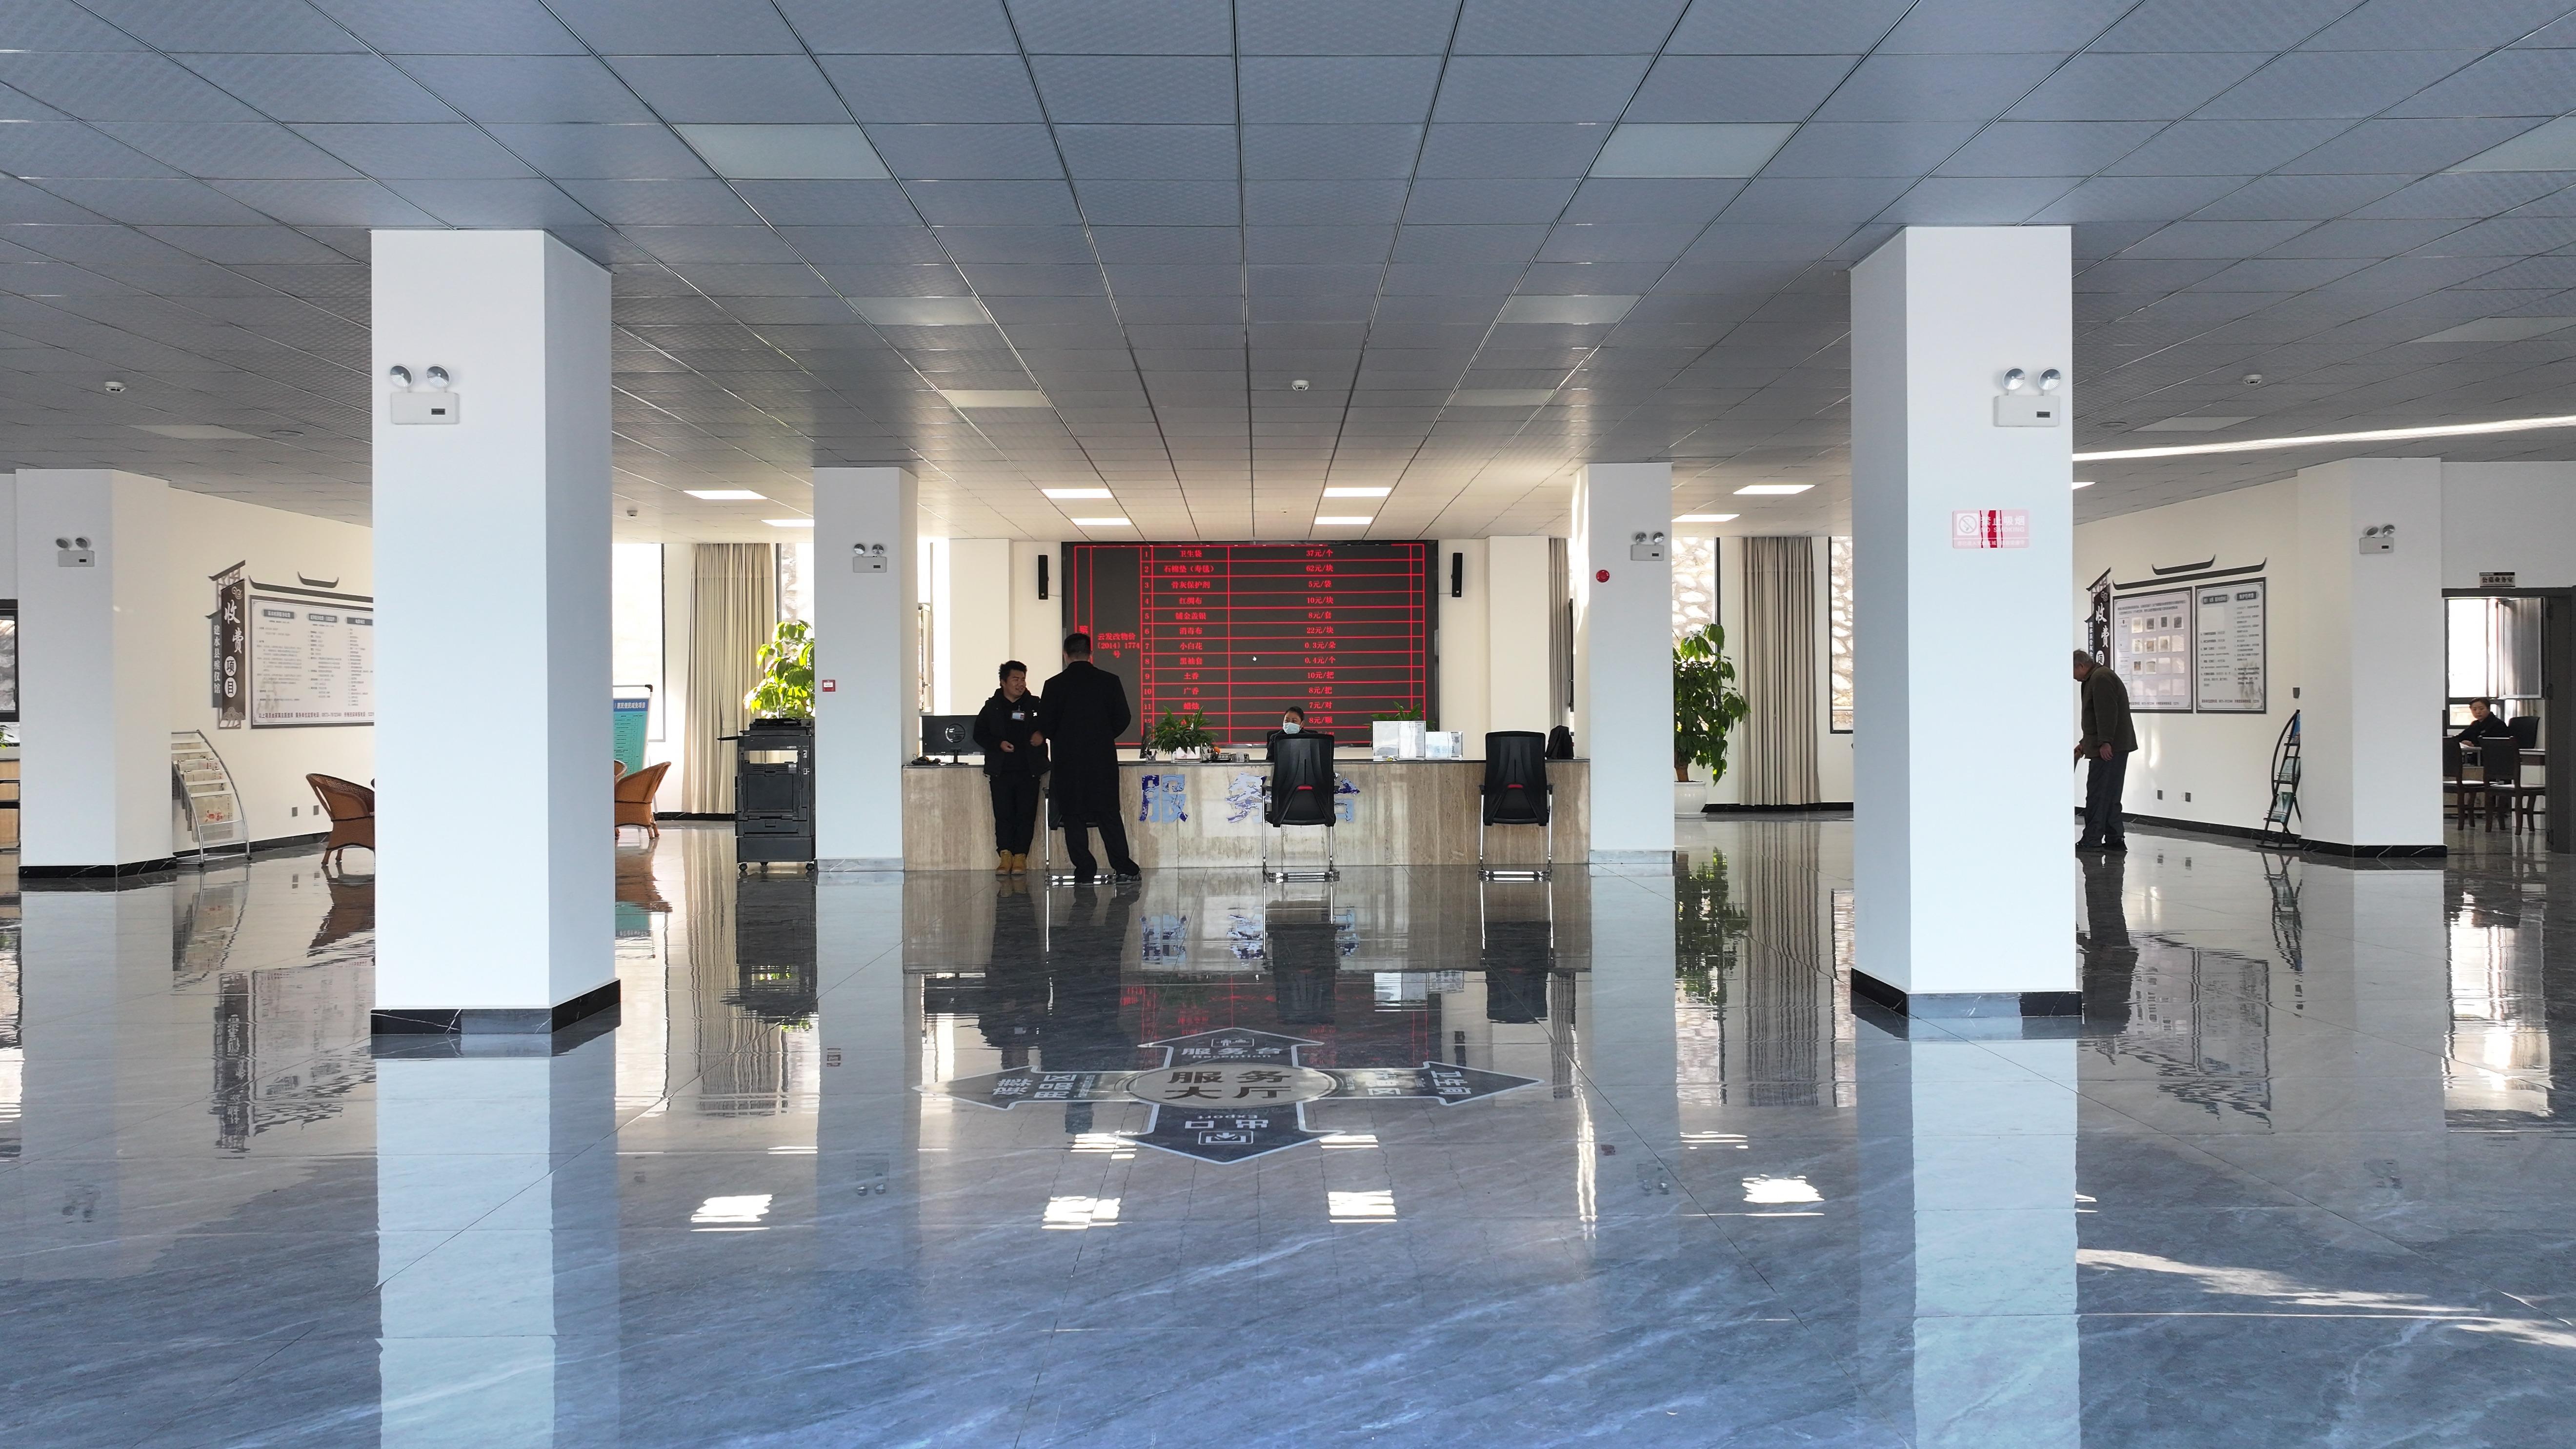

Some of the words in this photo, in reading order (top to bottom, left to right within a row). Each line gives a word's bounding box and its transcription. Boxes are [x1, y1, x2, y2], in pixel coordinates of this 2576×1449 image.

[1981, 516, 2025, 526] 禁止吸烟
[1171, 581, 1210, 589] 骨灰保护剂
[224, 599, 244, 695] 收费项目
[1167, 1071, 1292, 1084] 服务
[1430, 1070, 1471, 1095] 卫生间
[1034, 1074, 1076, 1099] 用品区
[1163, 1086, 1292, 1100] 大厅
[1185, 1119, 1268, 1129] 出口
